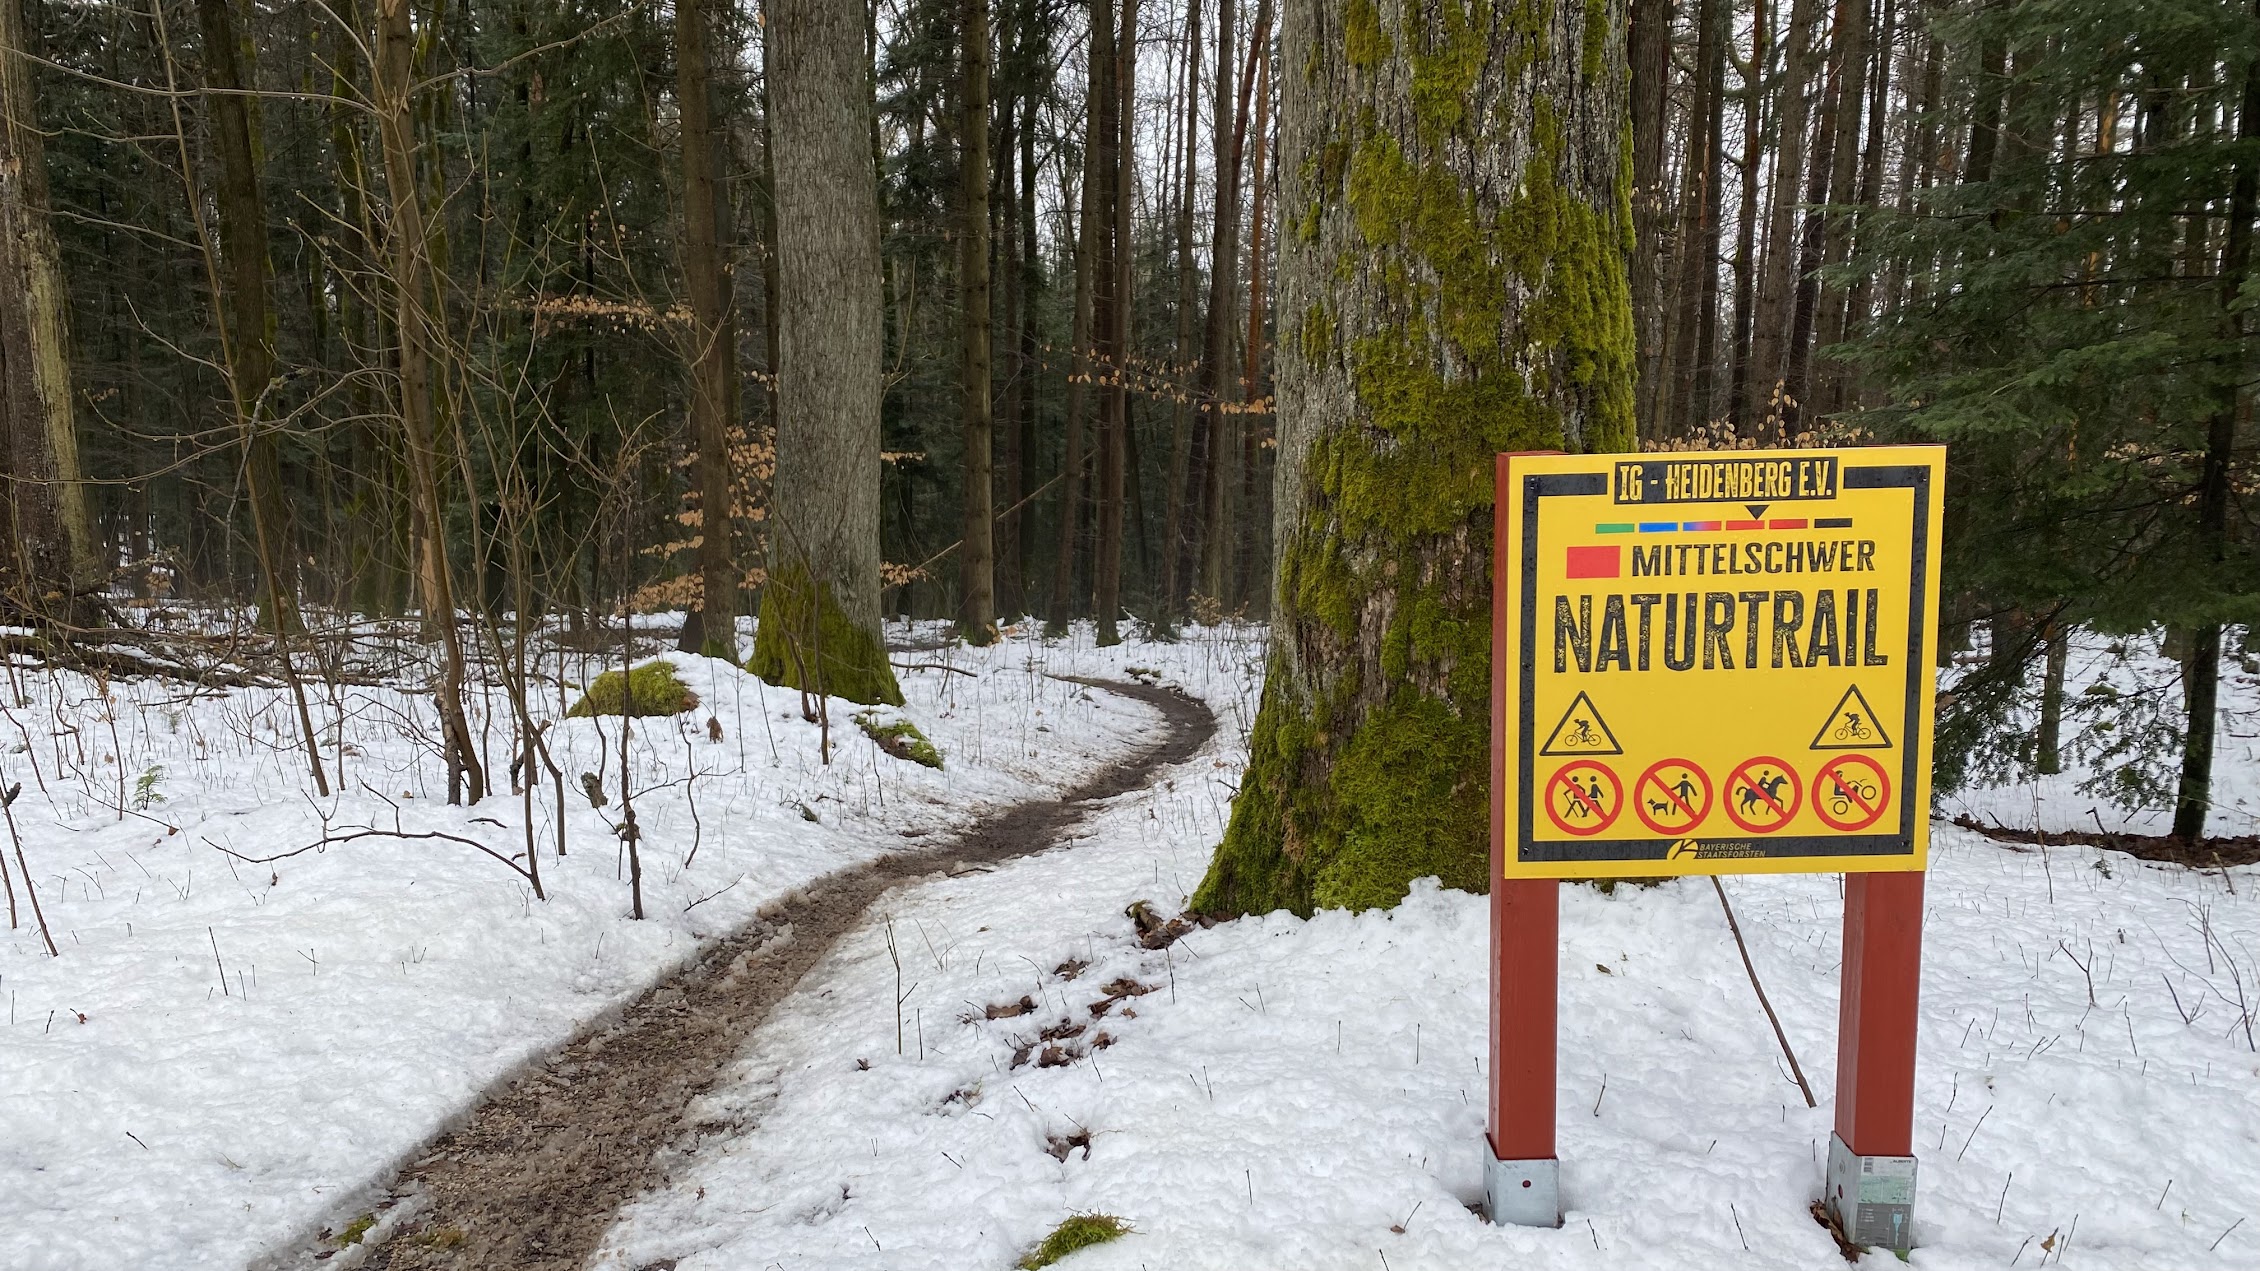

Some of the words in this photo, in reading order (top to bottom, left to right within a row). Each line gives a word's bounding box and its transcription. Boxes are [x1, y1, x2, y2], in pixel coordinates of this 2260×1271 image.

[1619, 465, 1643, 500] IG
[1665, 461, 1792, 499] HEIDENBERG
[1799, 460, 1832, 496] E.V.
[1632, 540, 1876, 577] MITTELSCHWER
[1554, 588, 1888, 673] NATURTRAIL
[1697, 850, 1766, 858] STAATSFORSTEN
